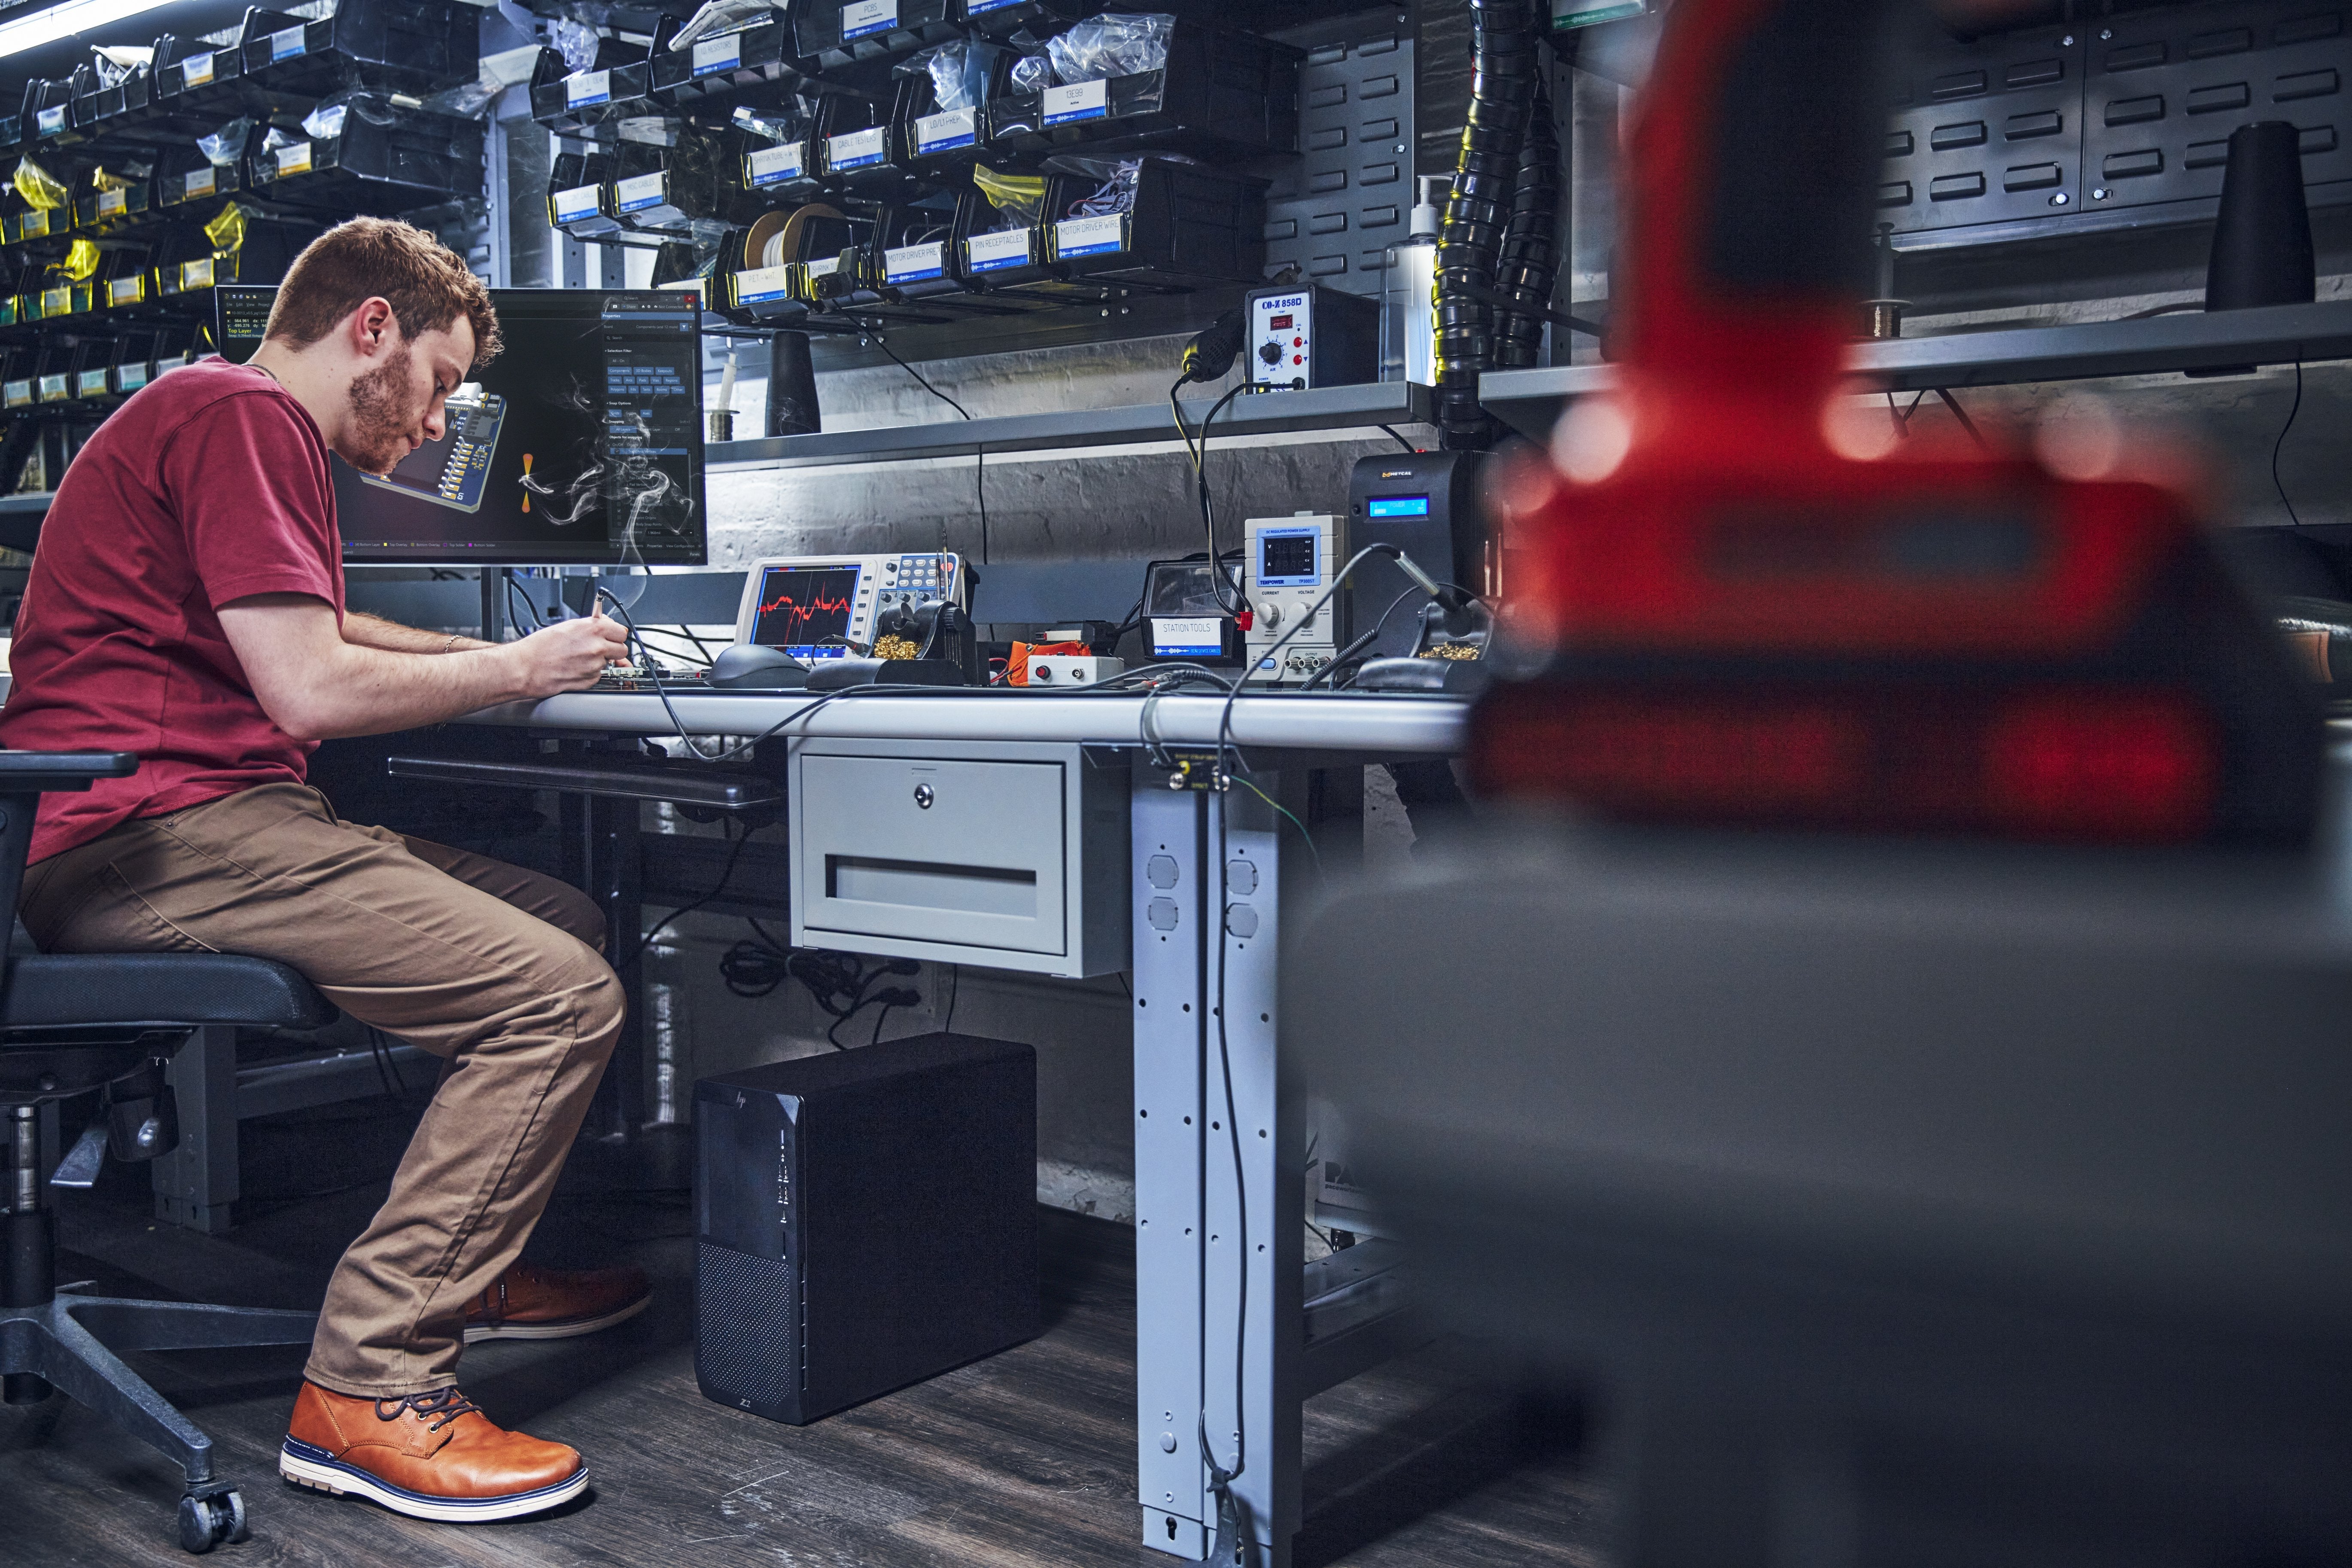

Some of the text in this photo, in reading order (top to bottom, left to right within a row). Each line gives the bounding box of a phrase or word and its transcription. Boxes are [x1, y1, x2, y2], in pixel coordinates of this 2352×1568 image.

[864, 3, 877, 13] PCBS
[1066, 88, 1083, 99] 13E99
[946, 115, 960, 125] PREP
[838, 134, 876, 149] CABLE TESTERS
[754, 156, 772, 164] SHRINK
[772, 153, 783, 162] TUBE
[639, 178, 655, 189] CABLES
[1061, 219, 1119, 235] MOTOR DRIVER WIRE
[976, 234, 1023, 249] PIN RECEPTACLES
[888, 247, 940, 262] MOTOR DRIVER PREP
[812, 265, 829, 274] SHRINK
[1262, 298, 1302, 310] CO-Z 858D
[1163, 624, 1211, 632] STATION TOOLS
